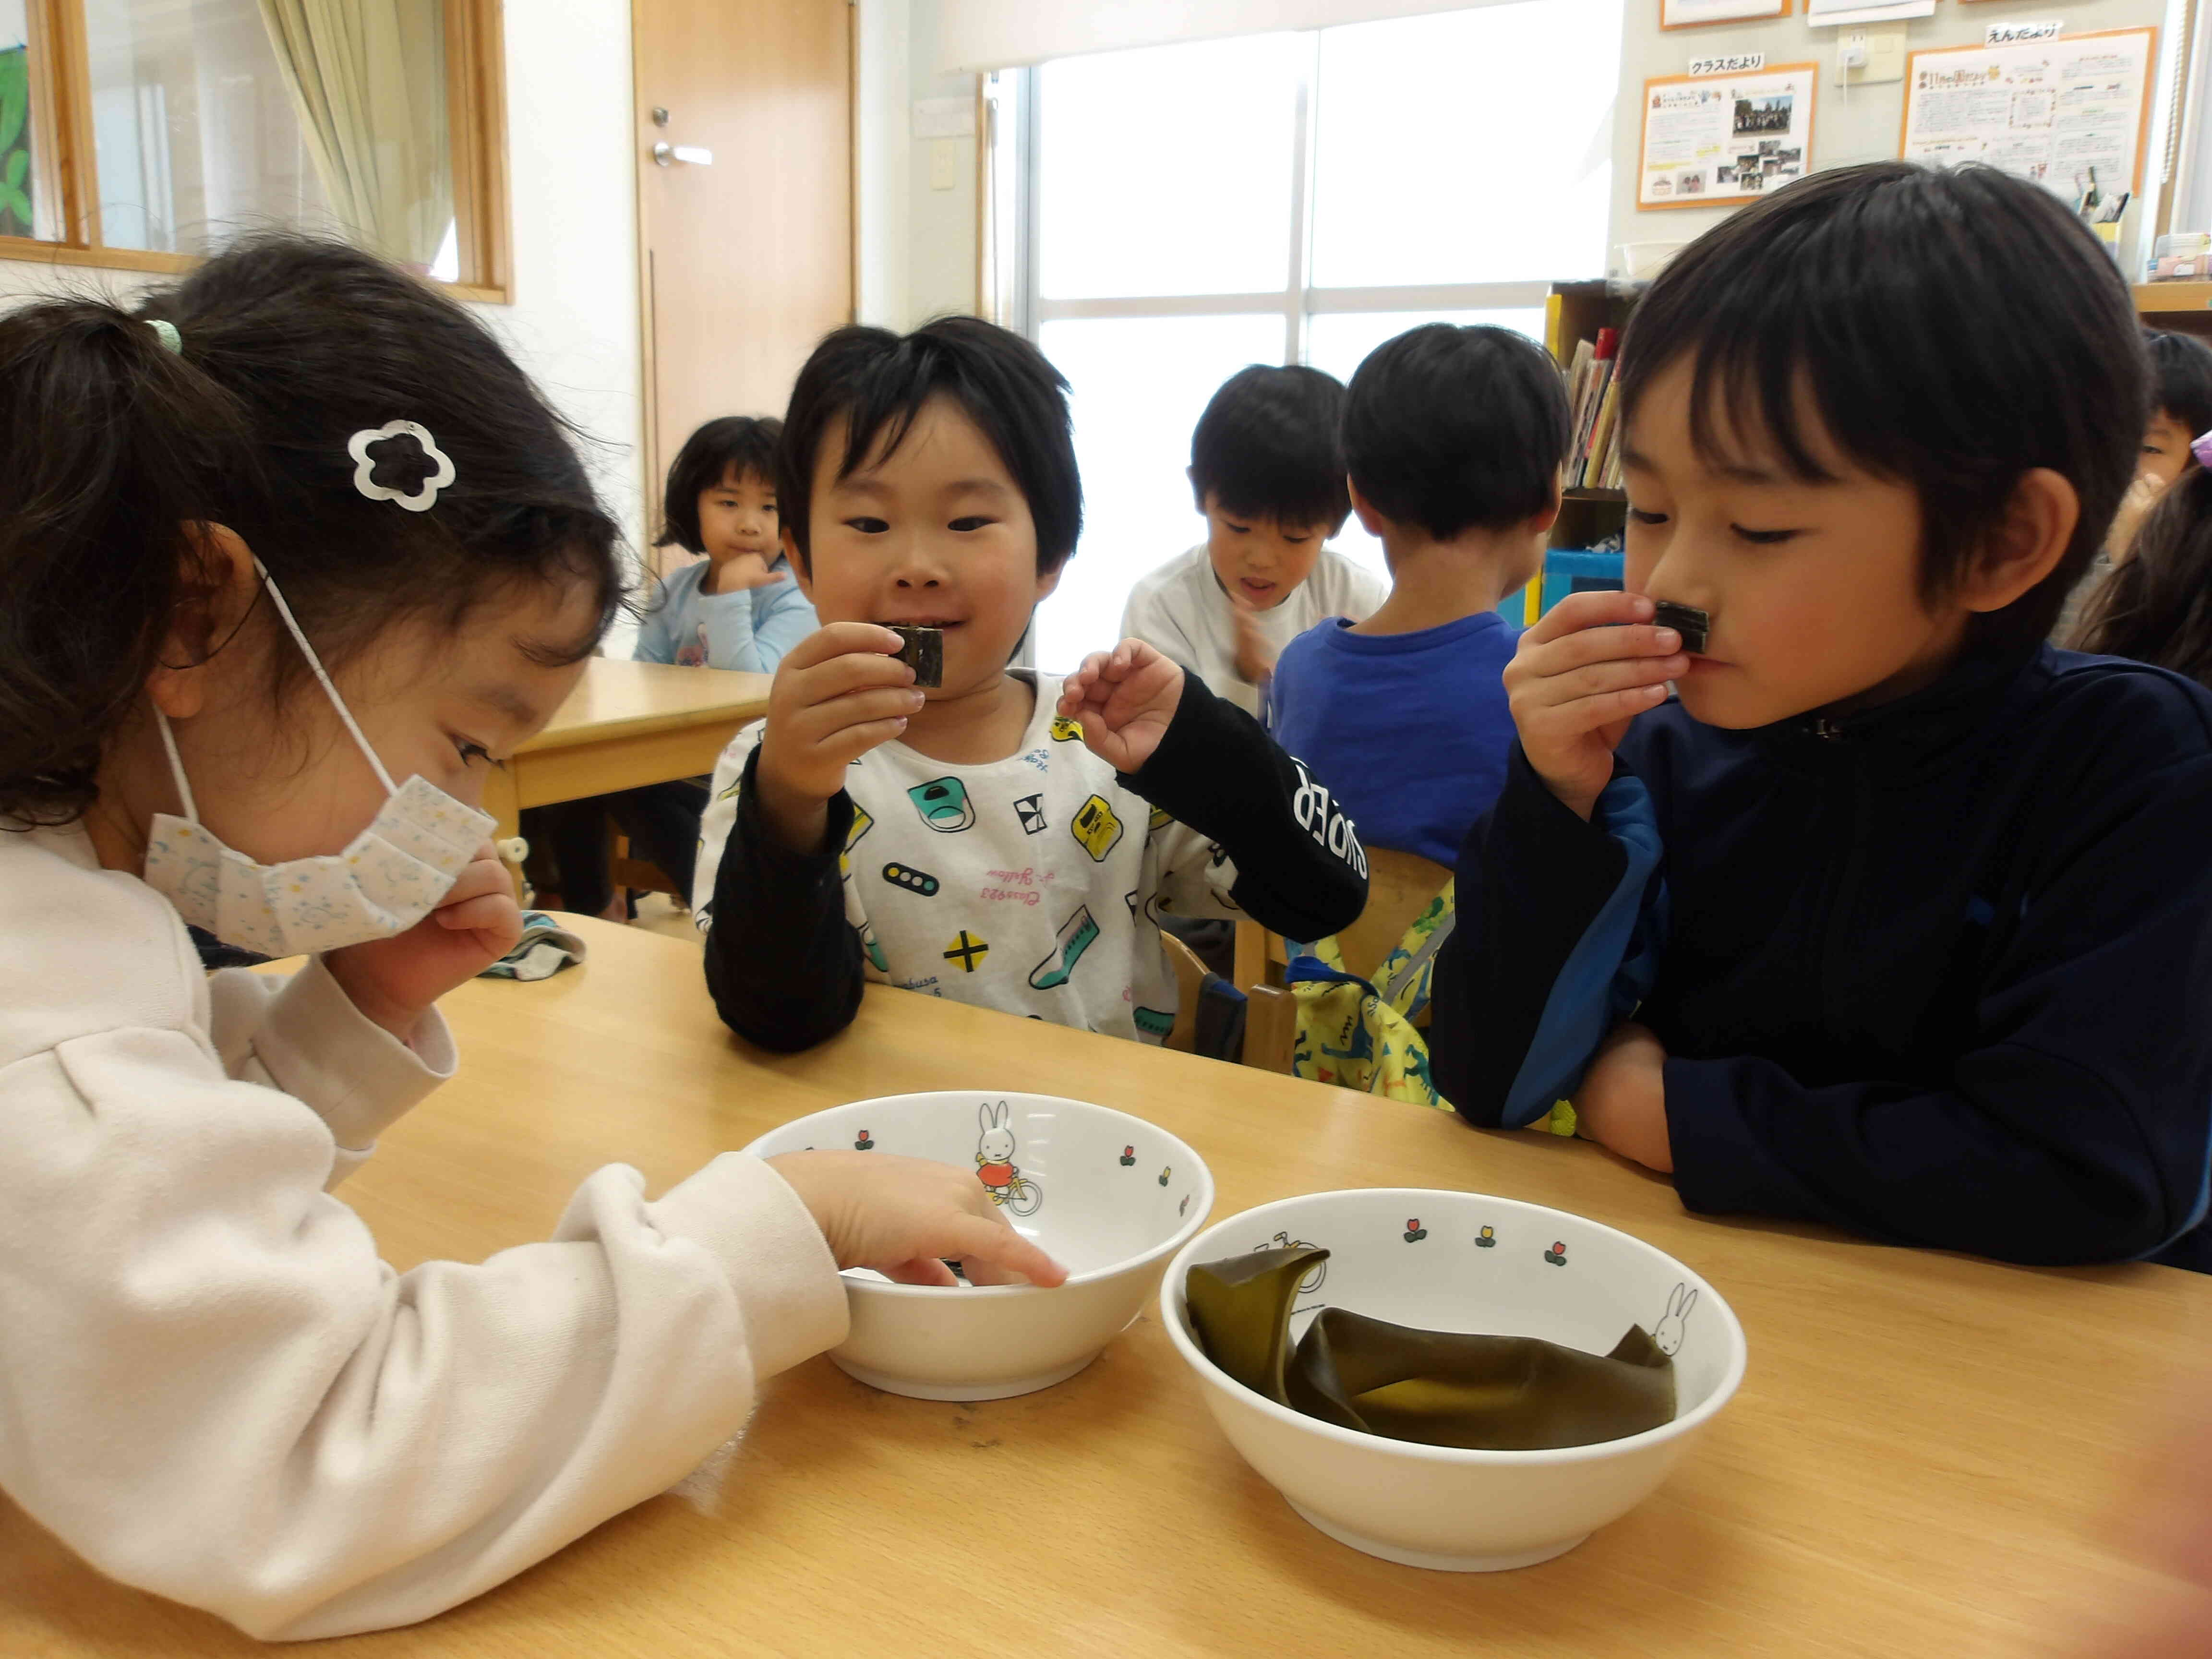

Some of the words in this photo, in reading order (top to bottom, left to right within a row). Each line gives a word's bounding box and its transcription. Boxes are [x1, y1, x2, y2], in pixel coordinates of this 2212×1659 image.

[1988, 23, 2056, 43] えんだより
[1692, 55, 1761, 74] クラスだより
